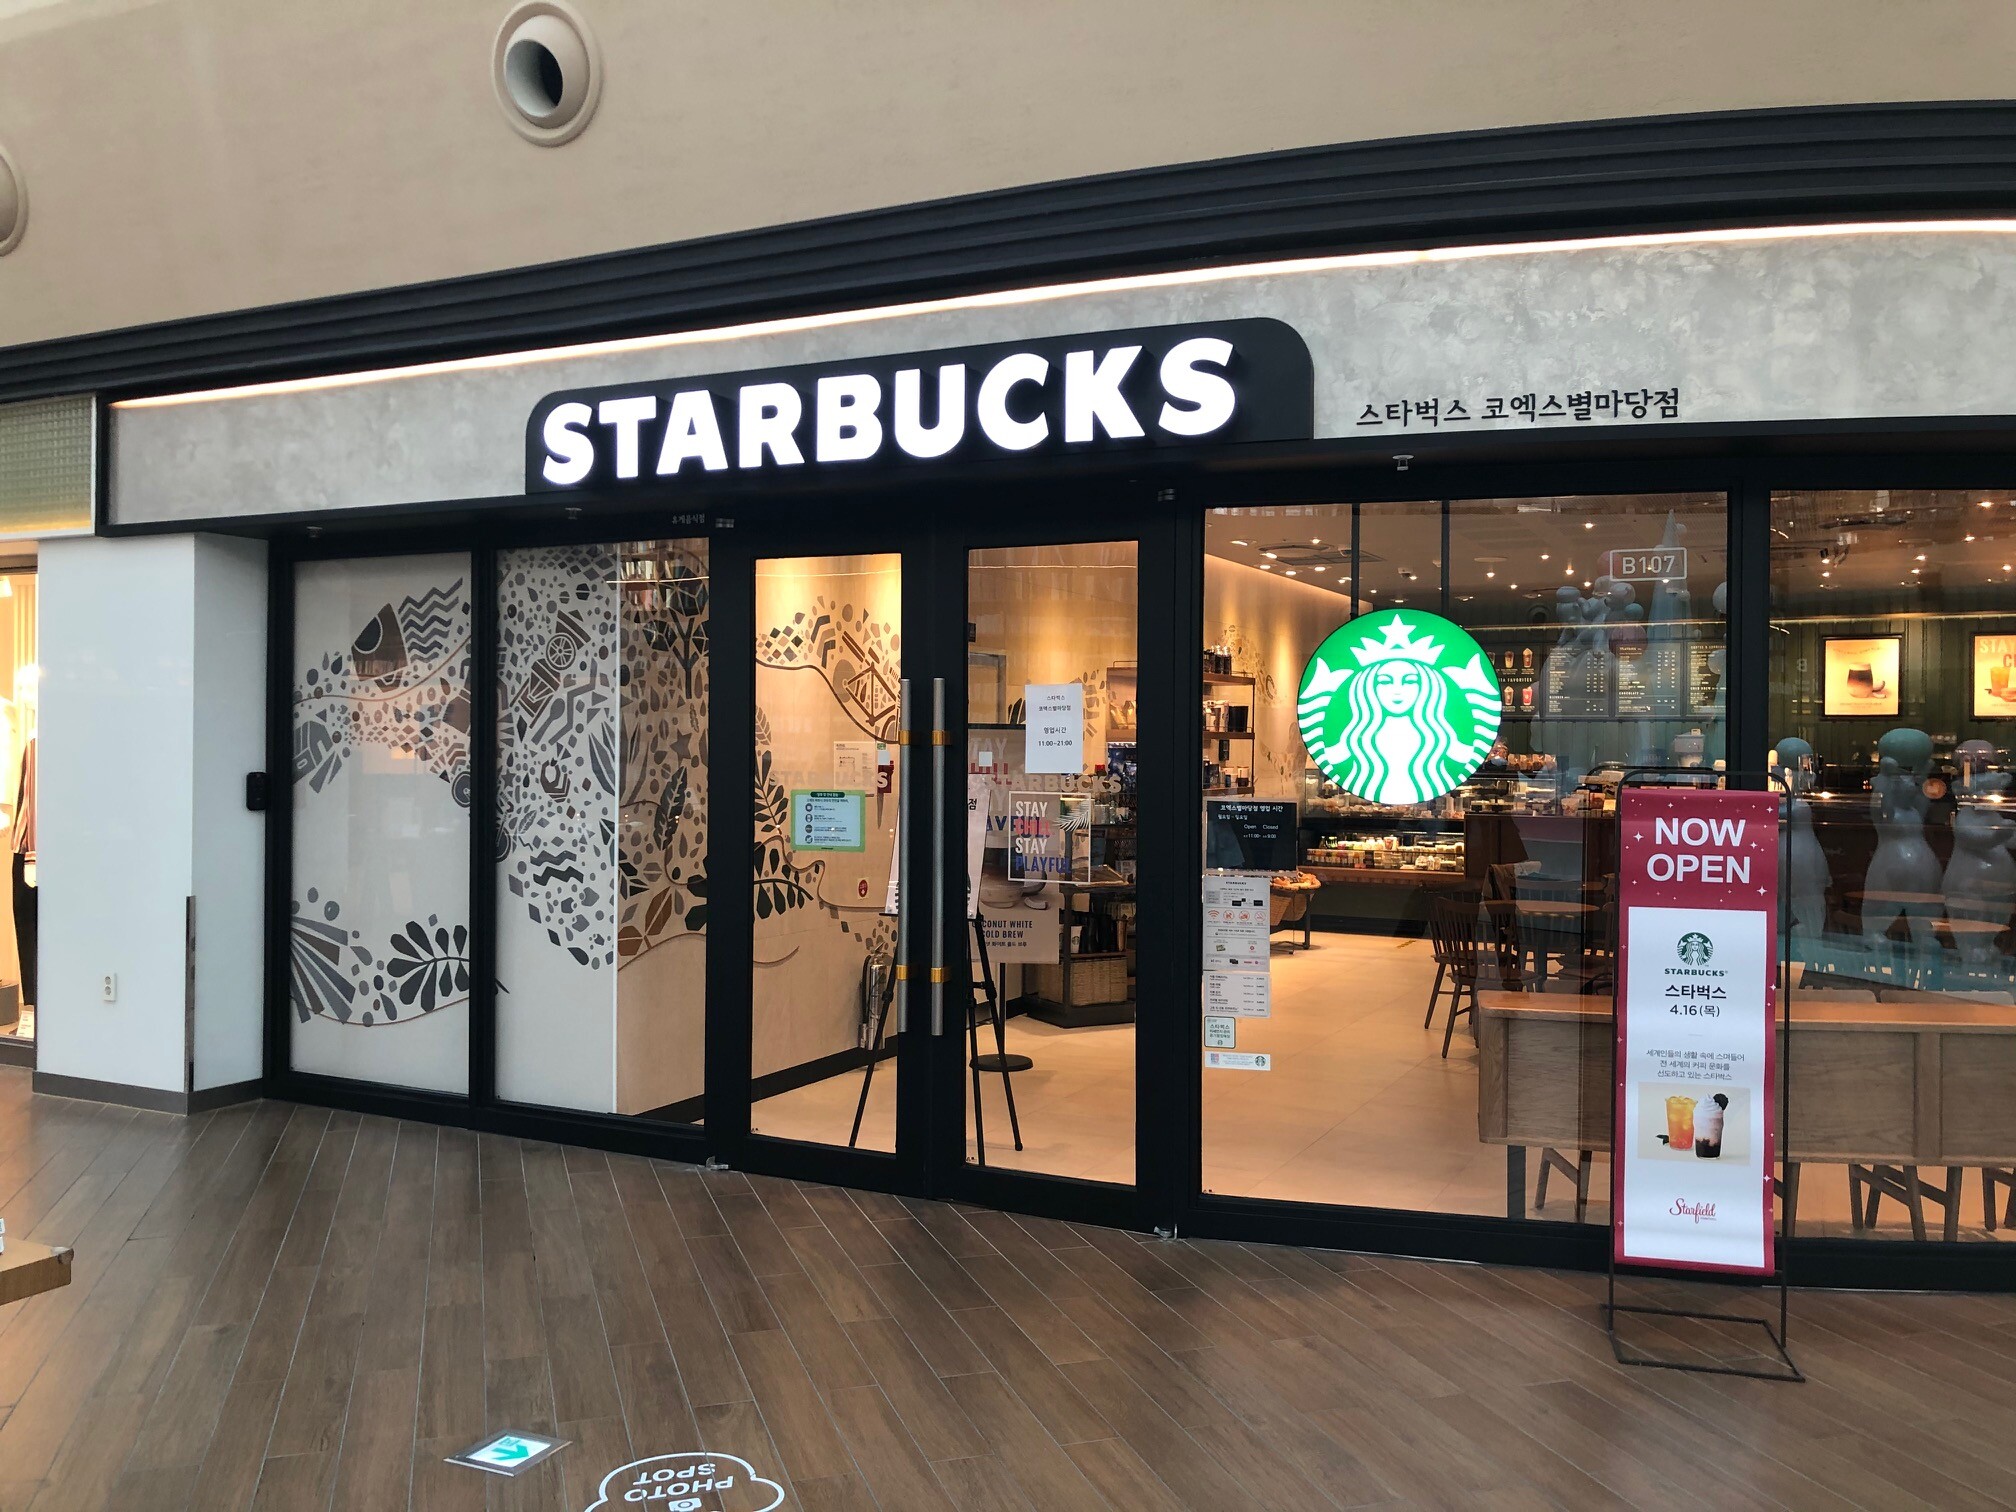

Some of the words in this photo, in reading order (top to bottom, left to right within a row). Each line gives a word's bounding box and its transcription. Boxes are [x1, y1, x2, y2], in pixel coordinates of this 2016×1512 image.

[541, 336, 1236, 486] STARBUCKS
[1356, 398, 1471, 427] 스타벅스
[1481, 387, 1679, 423] 코엑스별마당점
[1622, 555, 1675, 575] B107
[1043, 726, 1067, 734] 영업시간
[1015, 800, 1048, 818] STAY
[1655, 817, 1746, 847] NOW
[1015, 837, 1048, 855] STAY
[1646, 853, 1750, 884] OPEN
[1009, 920, 1033, 929] WHITE
[1002, 930, 1024, 939] BREW
[1664, 967, 1725, 977] STARBUCKS
[1664, 984, 1727, 1000] 스타벅스
[1646, 1049, 1681, 1059] 세계인들의
[1683, 1051, 1698, 1060] 생활
[1699, 1052, 1714, 1060] 속에
[1715, 1053, 1745, 1062] 스며들어
[1660, 1060, 1668, 1068] 전
[1669, 1060, 1691, 1069] 세계의
[1692, 1061, 1707, 1070] 커피
[1708, 1062, 1730, 1071] 문화를
[1657, 1070, 1685, 1078] 선도하고
[1687, 1071, 1702, 1080] 있는
[1703, 1072, 1732, 1081] 스타벅스
[1669, 1197, 1716, 1224] Starfield
[632, 1462, 717, 1486] SPOT
[623, 1475, 734, 1502] PHOTO
